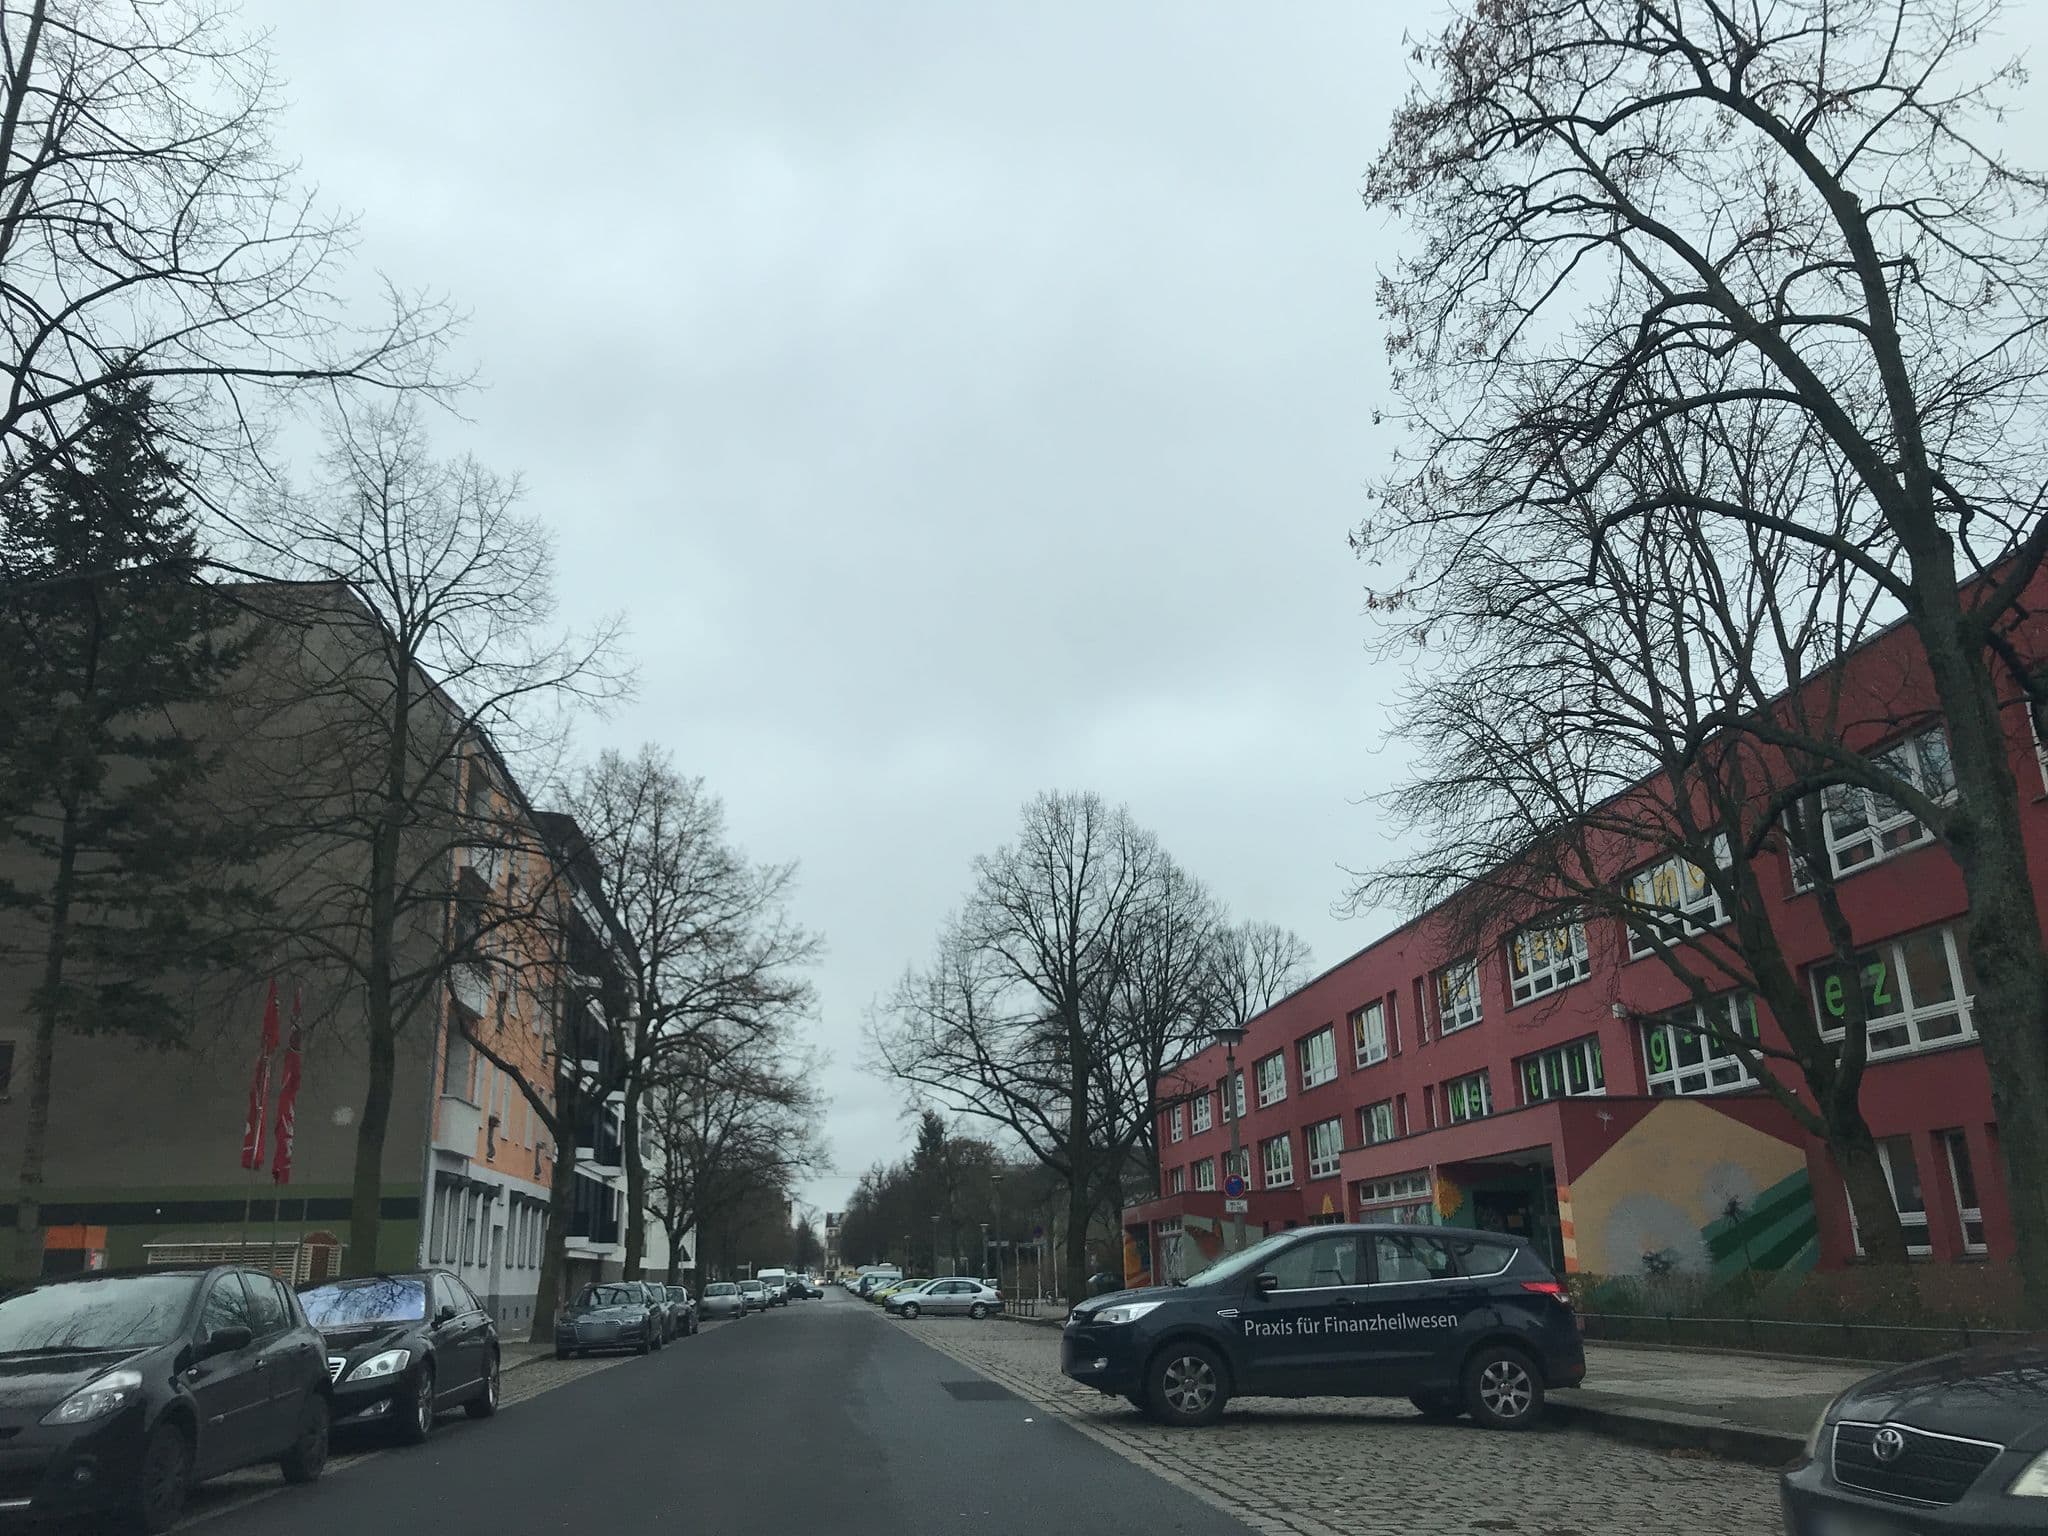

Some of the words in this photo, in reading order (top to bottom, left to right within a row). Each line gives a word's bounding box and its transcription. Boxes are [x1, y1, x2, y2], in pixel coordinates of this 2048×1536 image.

[1244, 1318, 1293, 1336] Praxis
[1296, 1316, 1321, 1335] für
[1323, 1312, 1459, 1334] Finanzheilwesen
